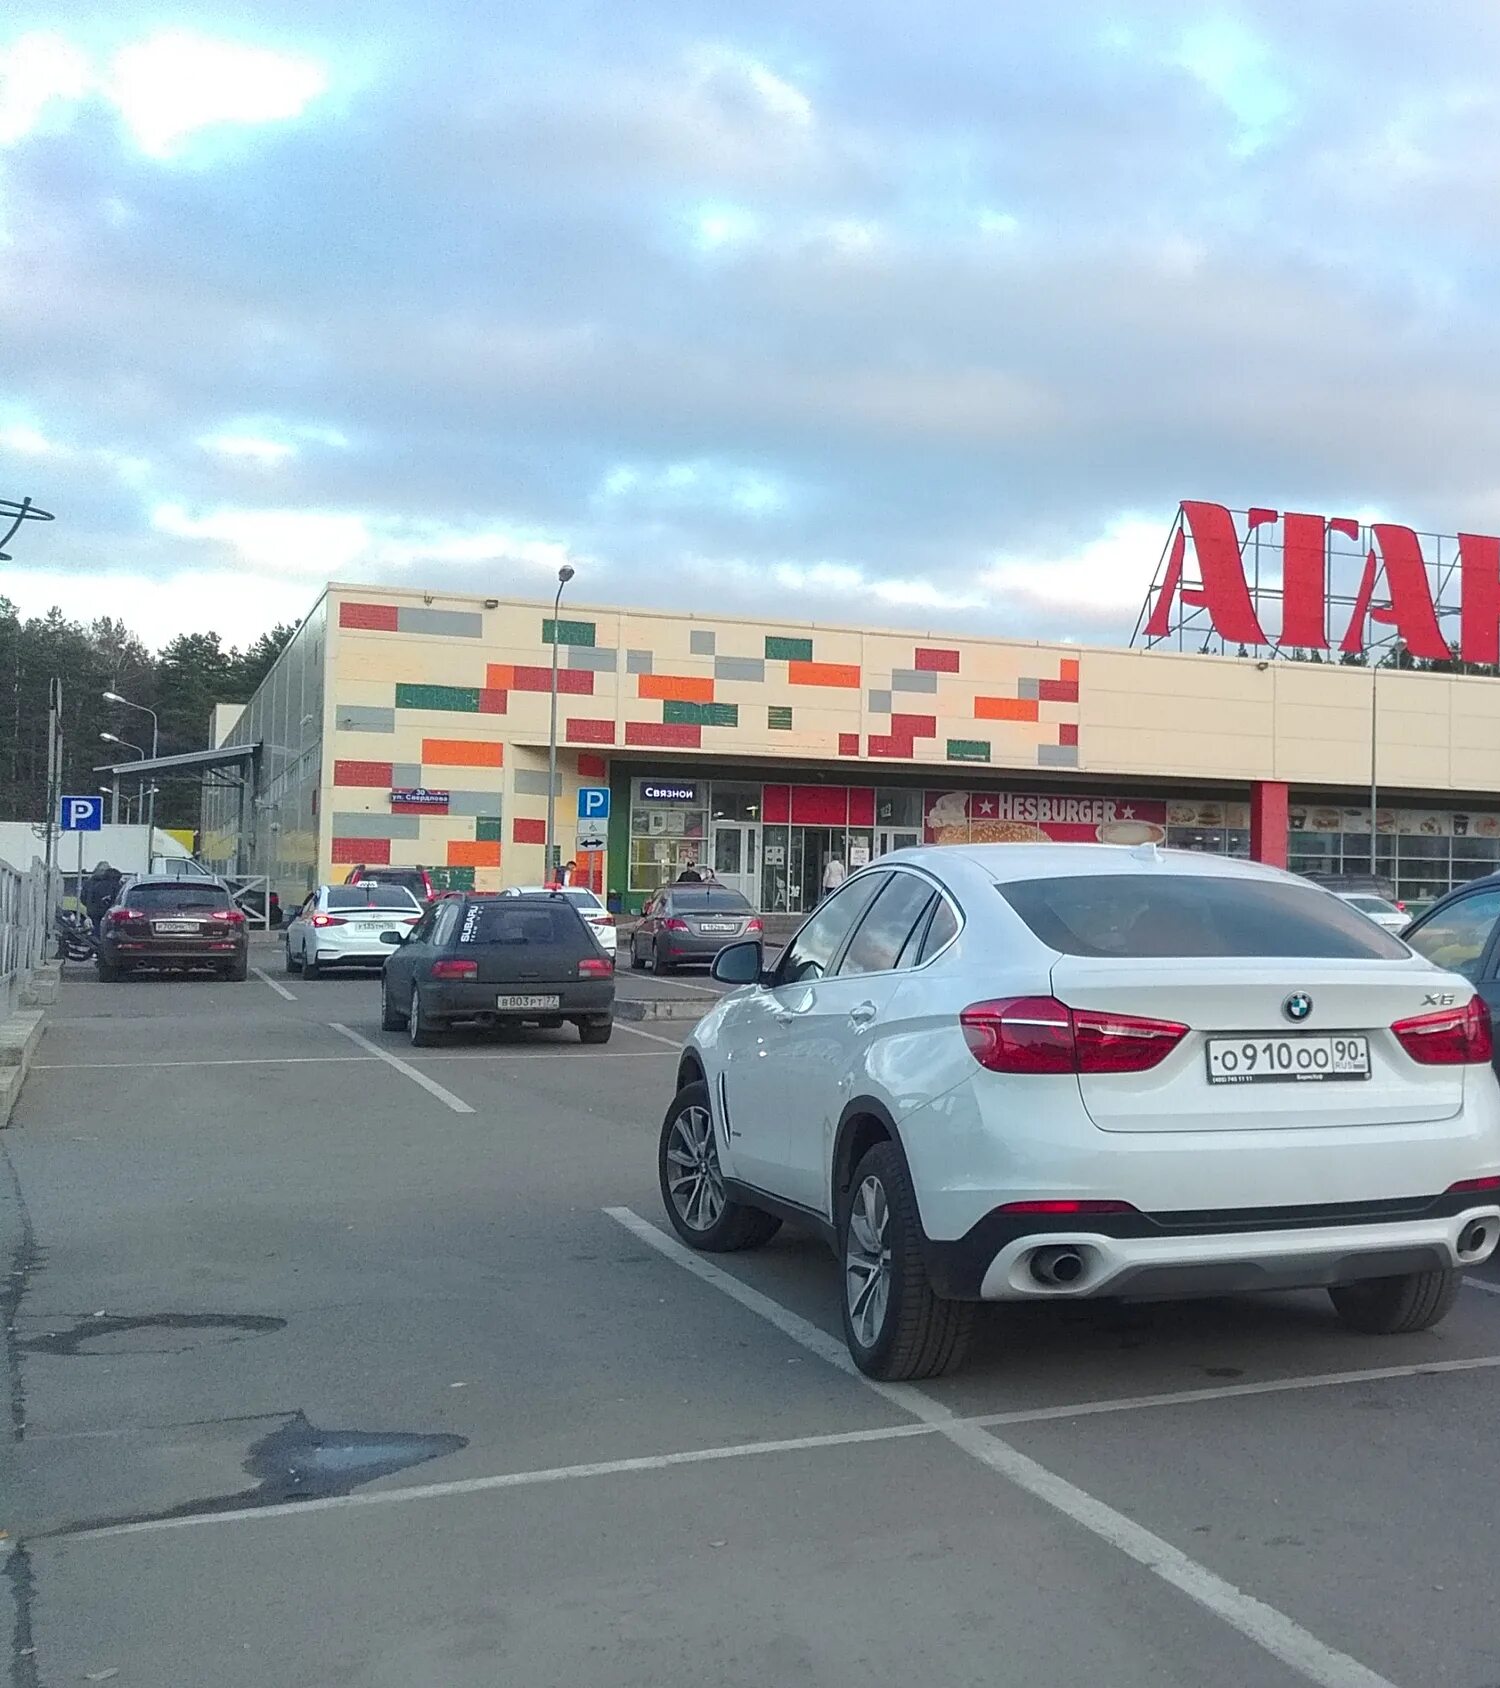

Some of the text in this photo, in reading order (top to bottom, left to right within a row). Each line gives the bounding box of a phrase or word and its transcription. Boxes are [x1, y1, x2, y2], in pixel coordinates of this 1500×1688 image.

[405, 794, 448, 802] Свердлова
[586, 791, 604, 816] P
[999, 793, 1117, 823] HESBURGER
[71, 800, 93, 828] P
[461, 905, 479, 943] SUBARU
[1421, 994, 1455, 1006] X6
[1335, 1040, 1359, 1061] 90
[1335, 1061, 1352, 1069] RUS
